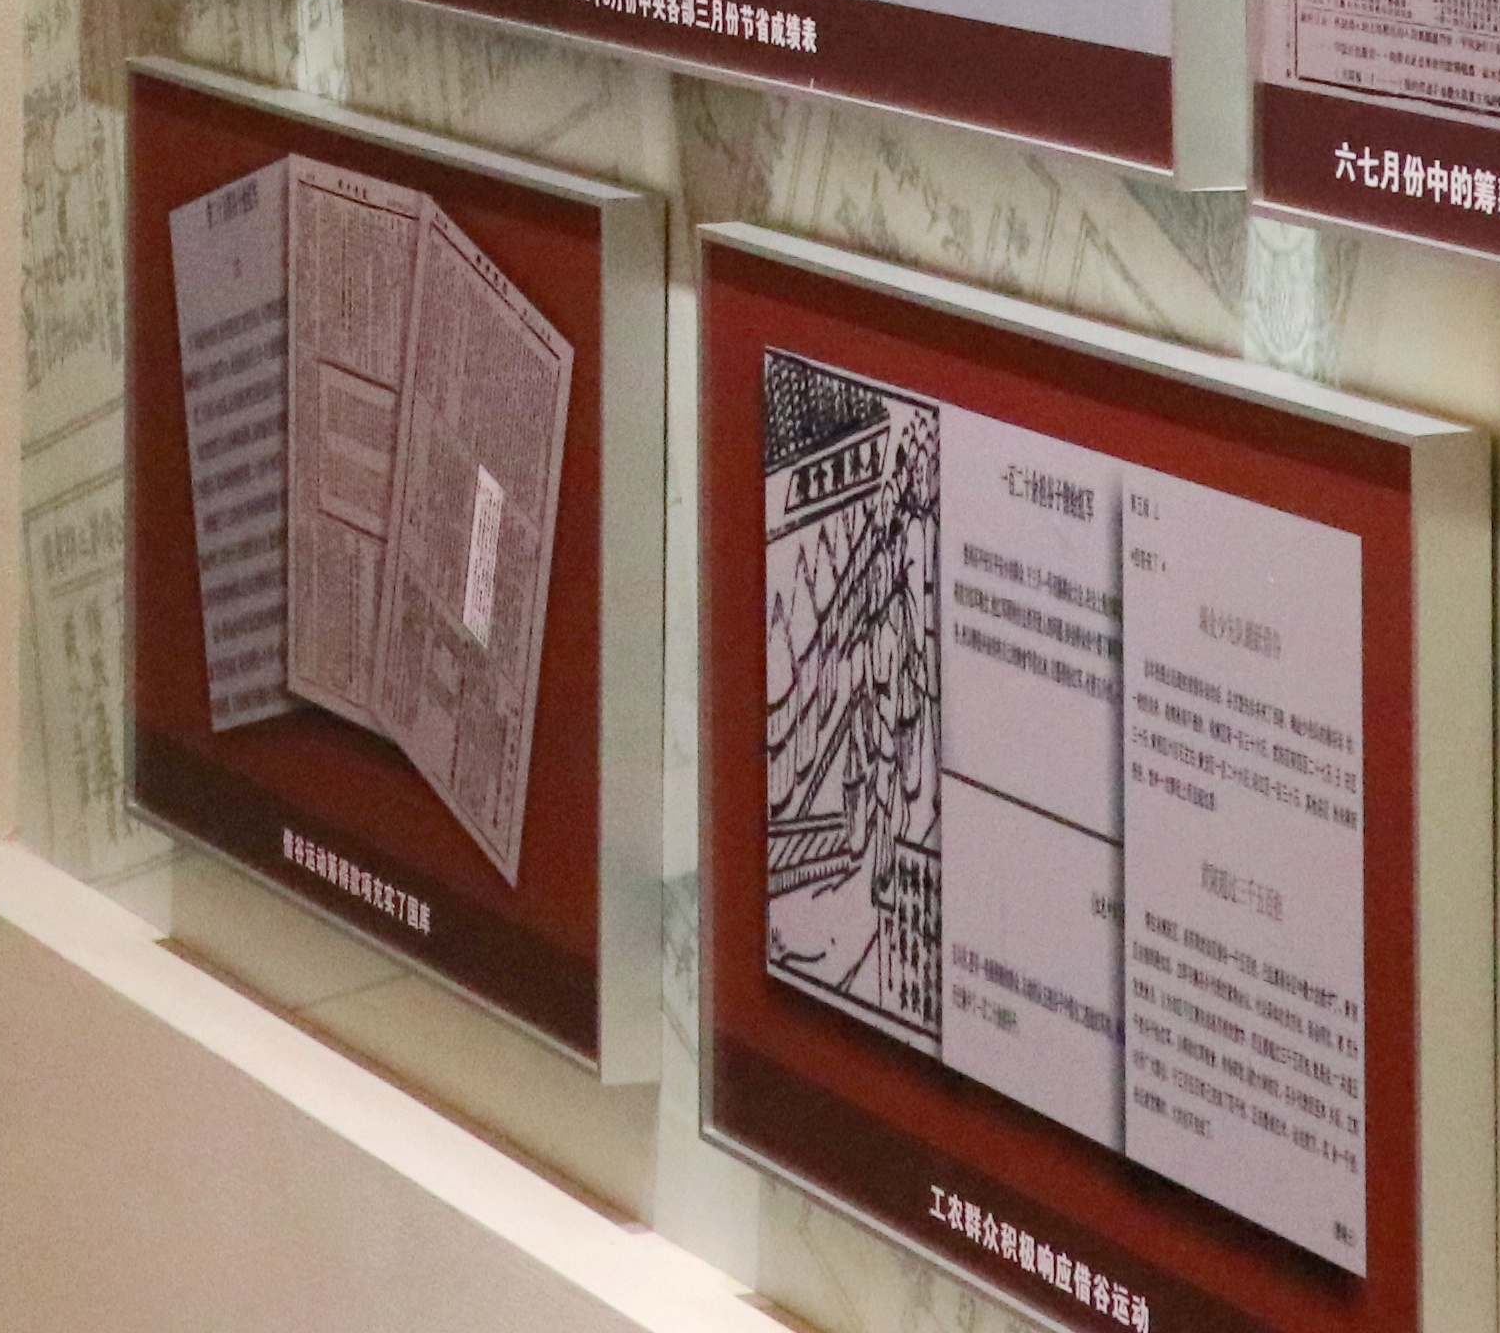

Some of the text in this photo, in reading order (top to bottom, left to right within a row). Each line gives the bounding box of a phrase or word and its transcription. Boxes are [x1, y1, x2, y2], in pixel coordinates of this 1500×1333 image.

[929, 1185, 1150, 1333] 工农群众积极响应借谷运动
